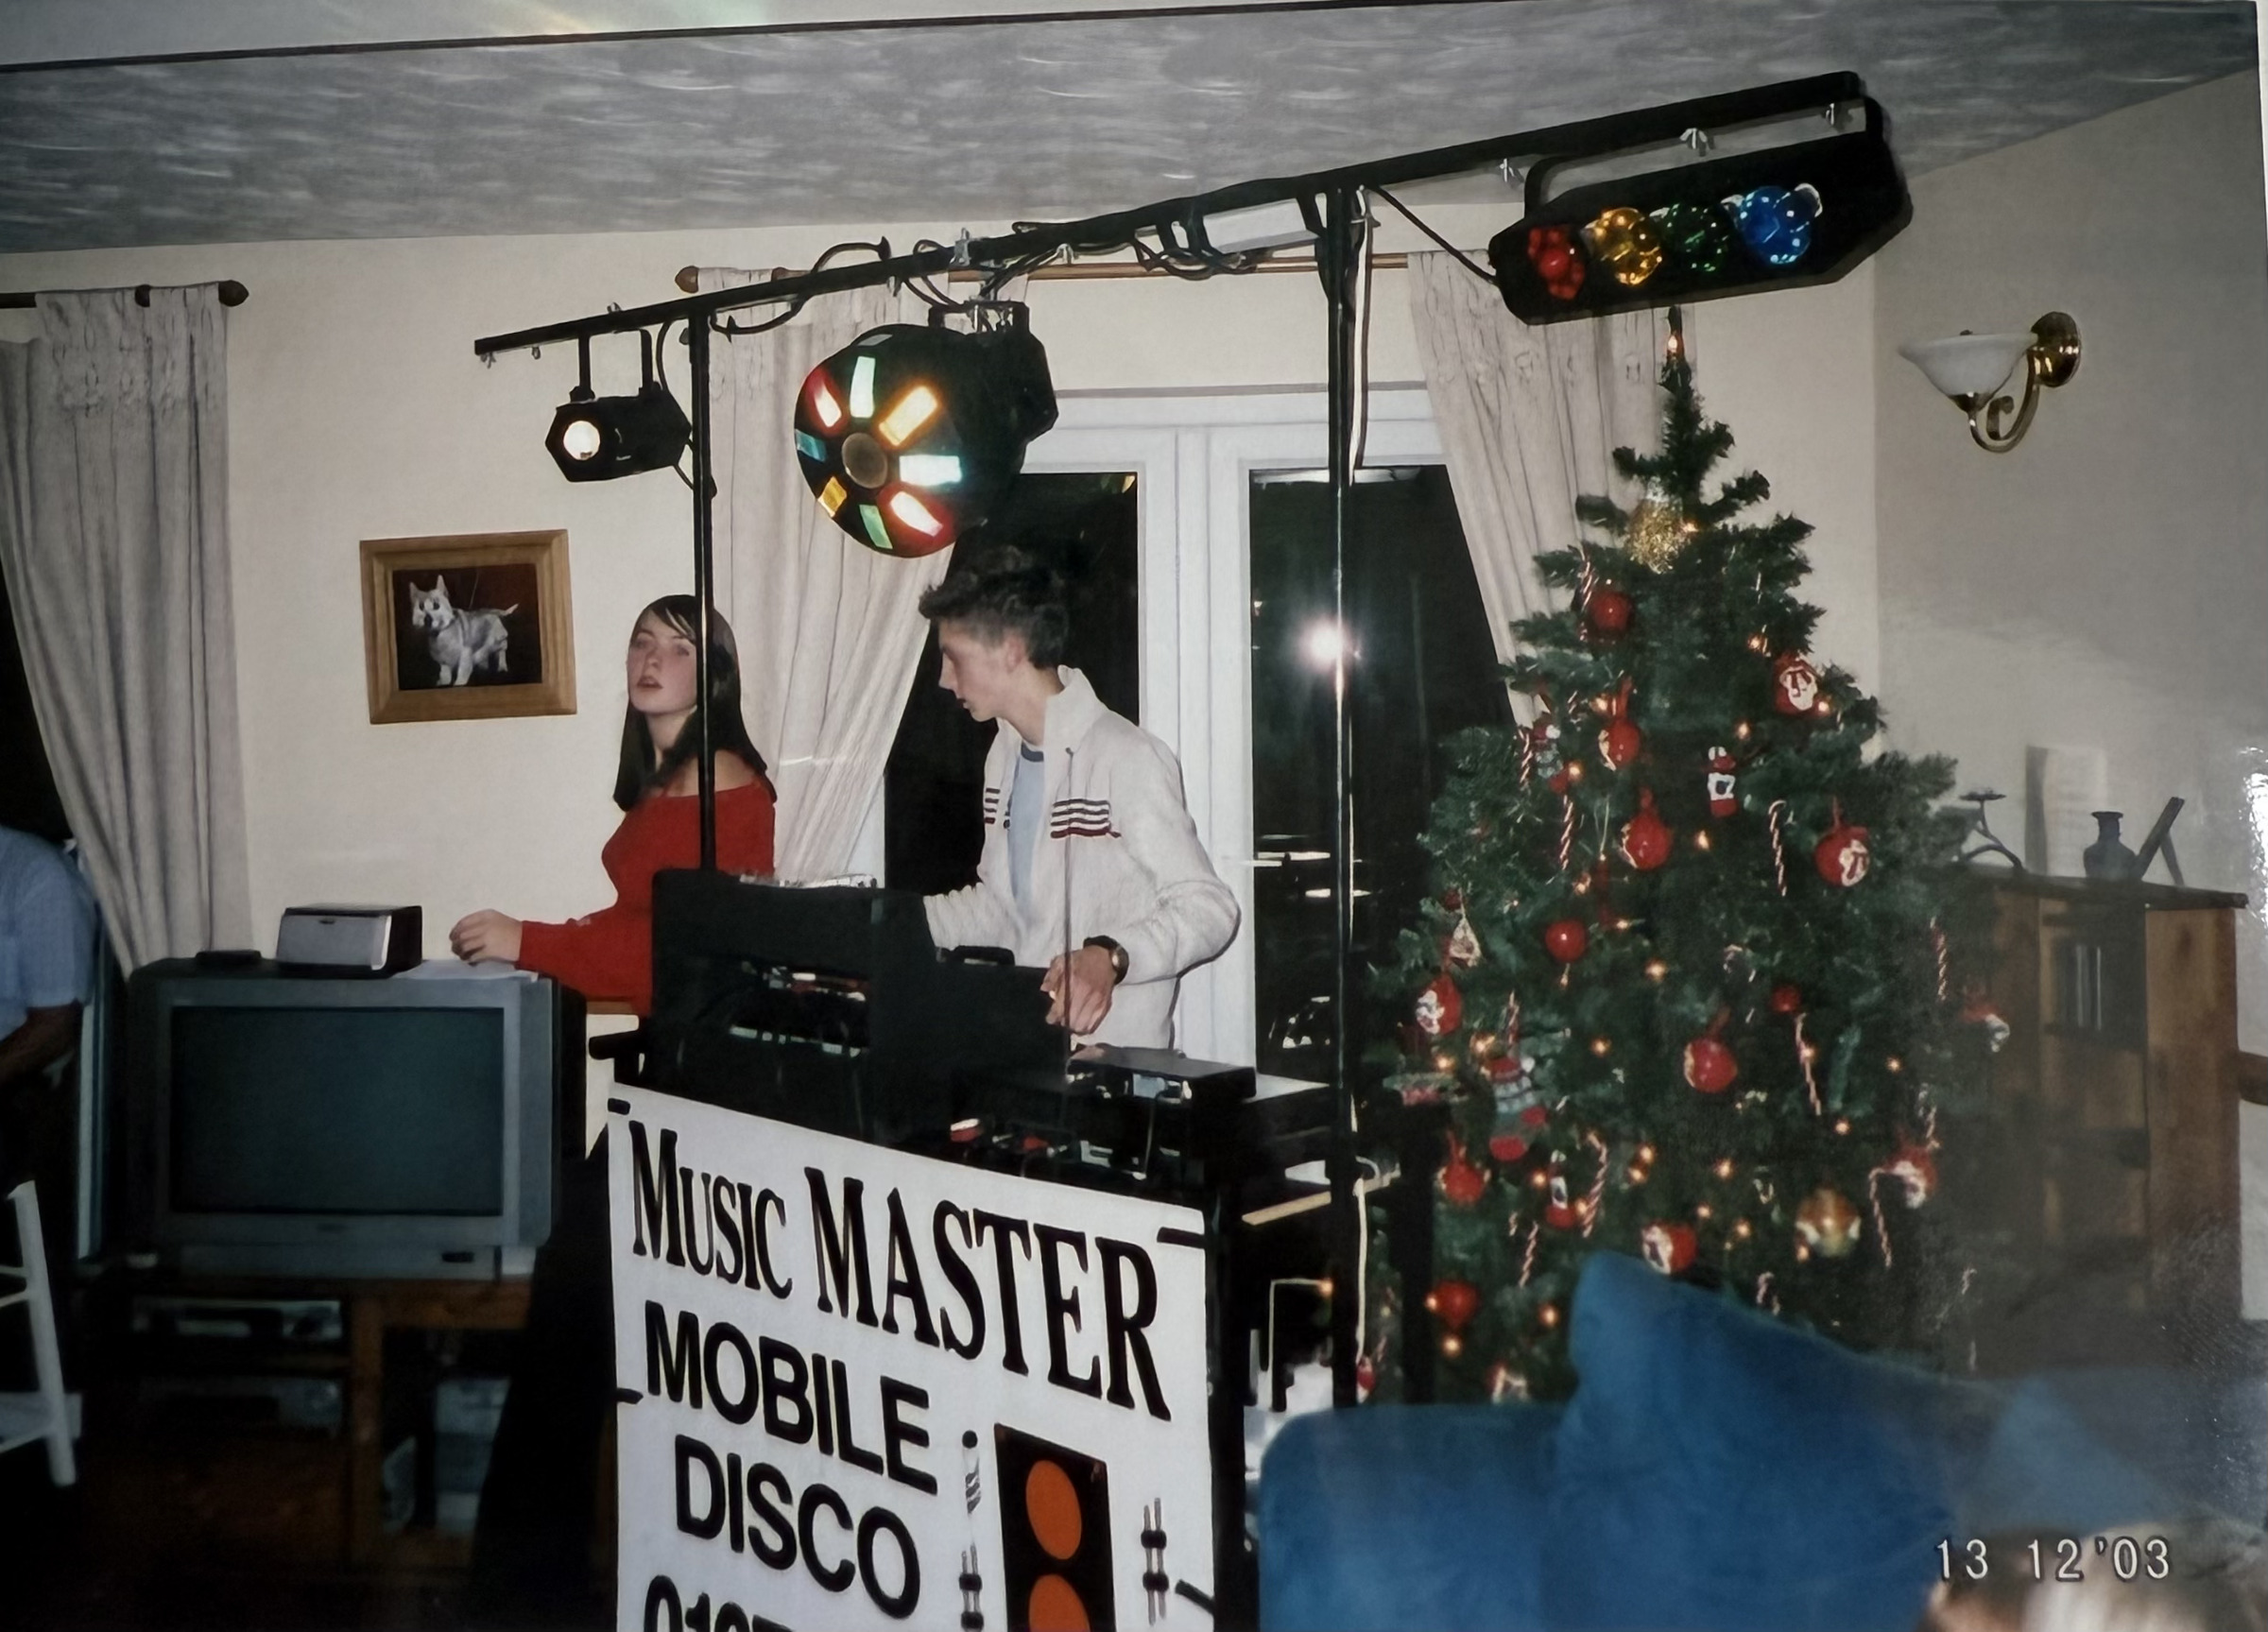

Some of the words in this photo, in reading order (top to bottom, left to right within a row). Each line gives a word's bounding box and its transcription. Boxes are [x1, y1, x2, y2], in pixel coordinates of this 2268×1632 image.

[627, 1120, 793, 1299] MUSIC
[803, 1166, 1172, 1422] MASTER
[644, 1299, 938, 1496] MOBILE
[674, 1434, 921, 1621] DISCO
